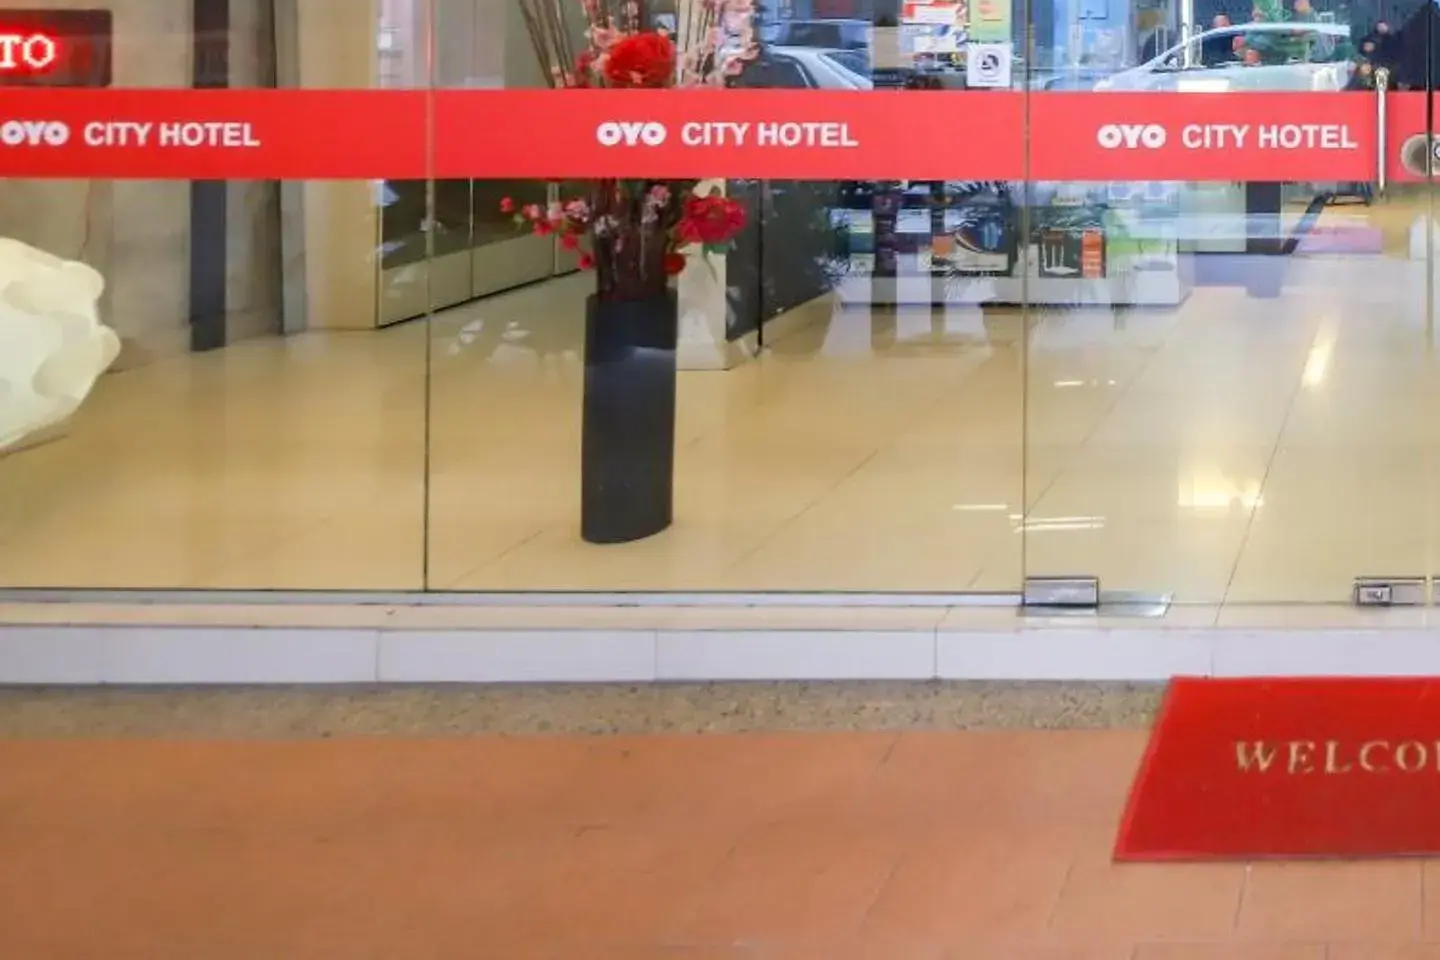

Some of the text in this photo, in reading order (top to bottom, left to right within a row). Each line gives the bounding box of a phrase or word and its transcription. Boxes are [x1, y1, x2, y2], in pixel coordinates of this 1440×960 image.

[0, 120, 260, 146] OYO CITY HOTEL
[596, 121, 858, 147] OYO CITY HOTEL
[1096, 123, 1358, 149] OYO CITY HOTEL
